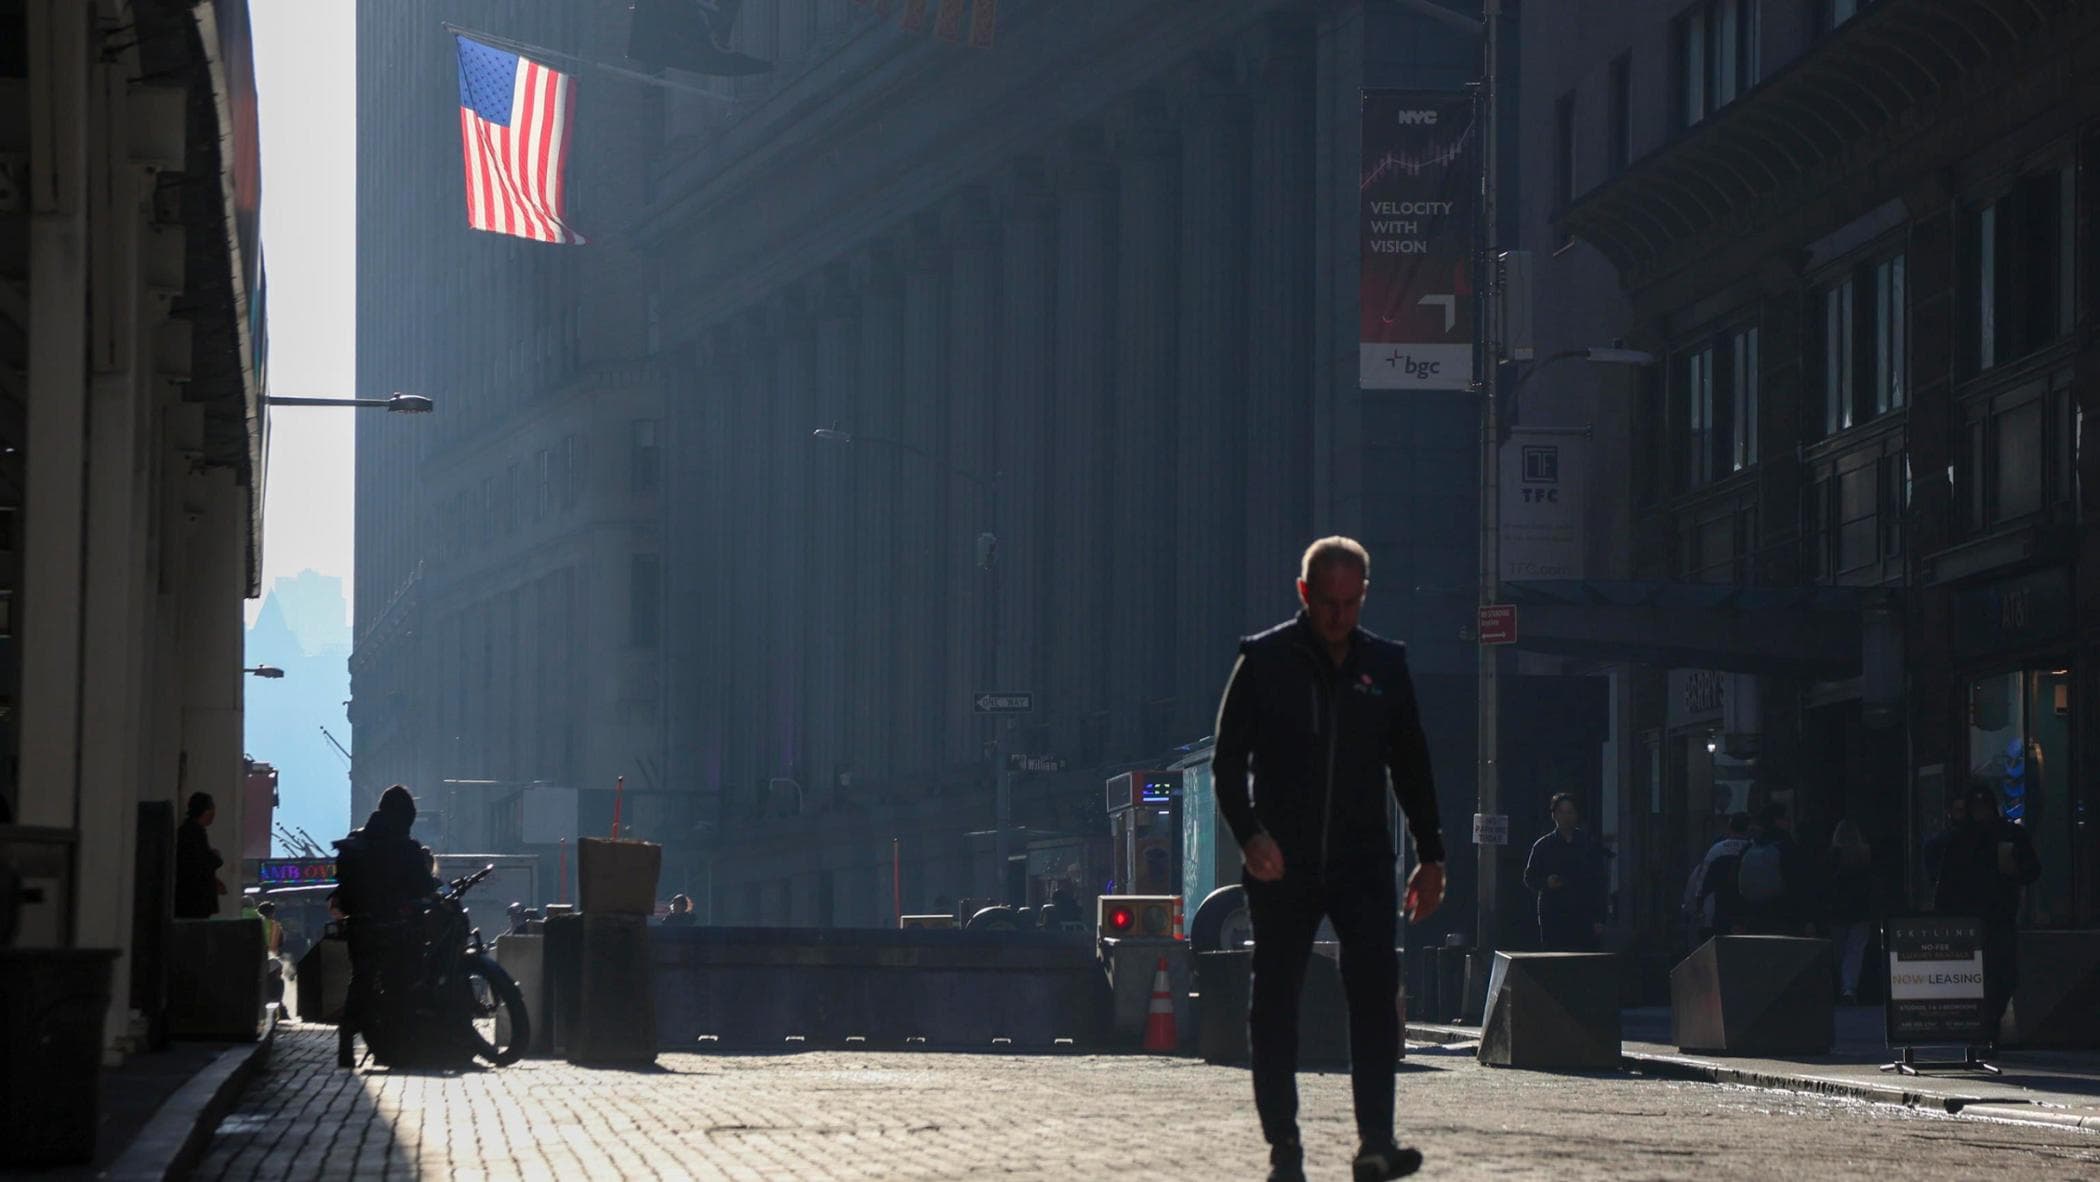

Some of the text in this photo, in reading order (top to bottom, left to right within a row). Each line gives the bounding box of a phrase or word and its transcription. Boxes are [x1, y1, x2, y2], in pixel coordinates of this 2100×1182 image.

[1398, 110, 1438, 125] NYC
[1370, 201, 1453, 216] VELOCITY
[1370, 221, 1418, 235] WITH
[1370, 241, 1428, 254] VISION
[1404, 356, 1441, 379] bgc
[1522, 488, 1559, 503] TFC
[1892, 973, 1982, 984] NOW LEASING
